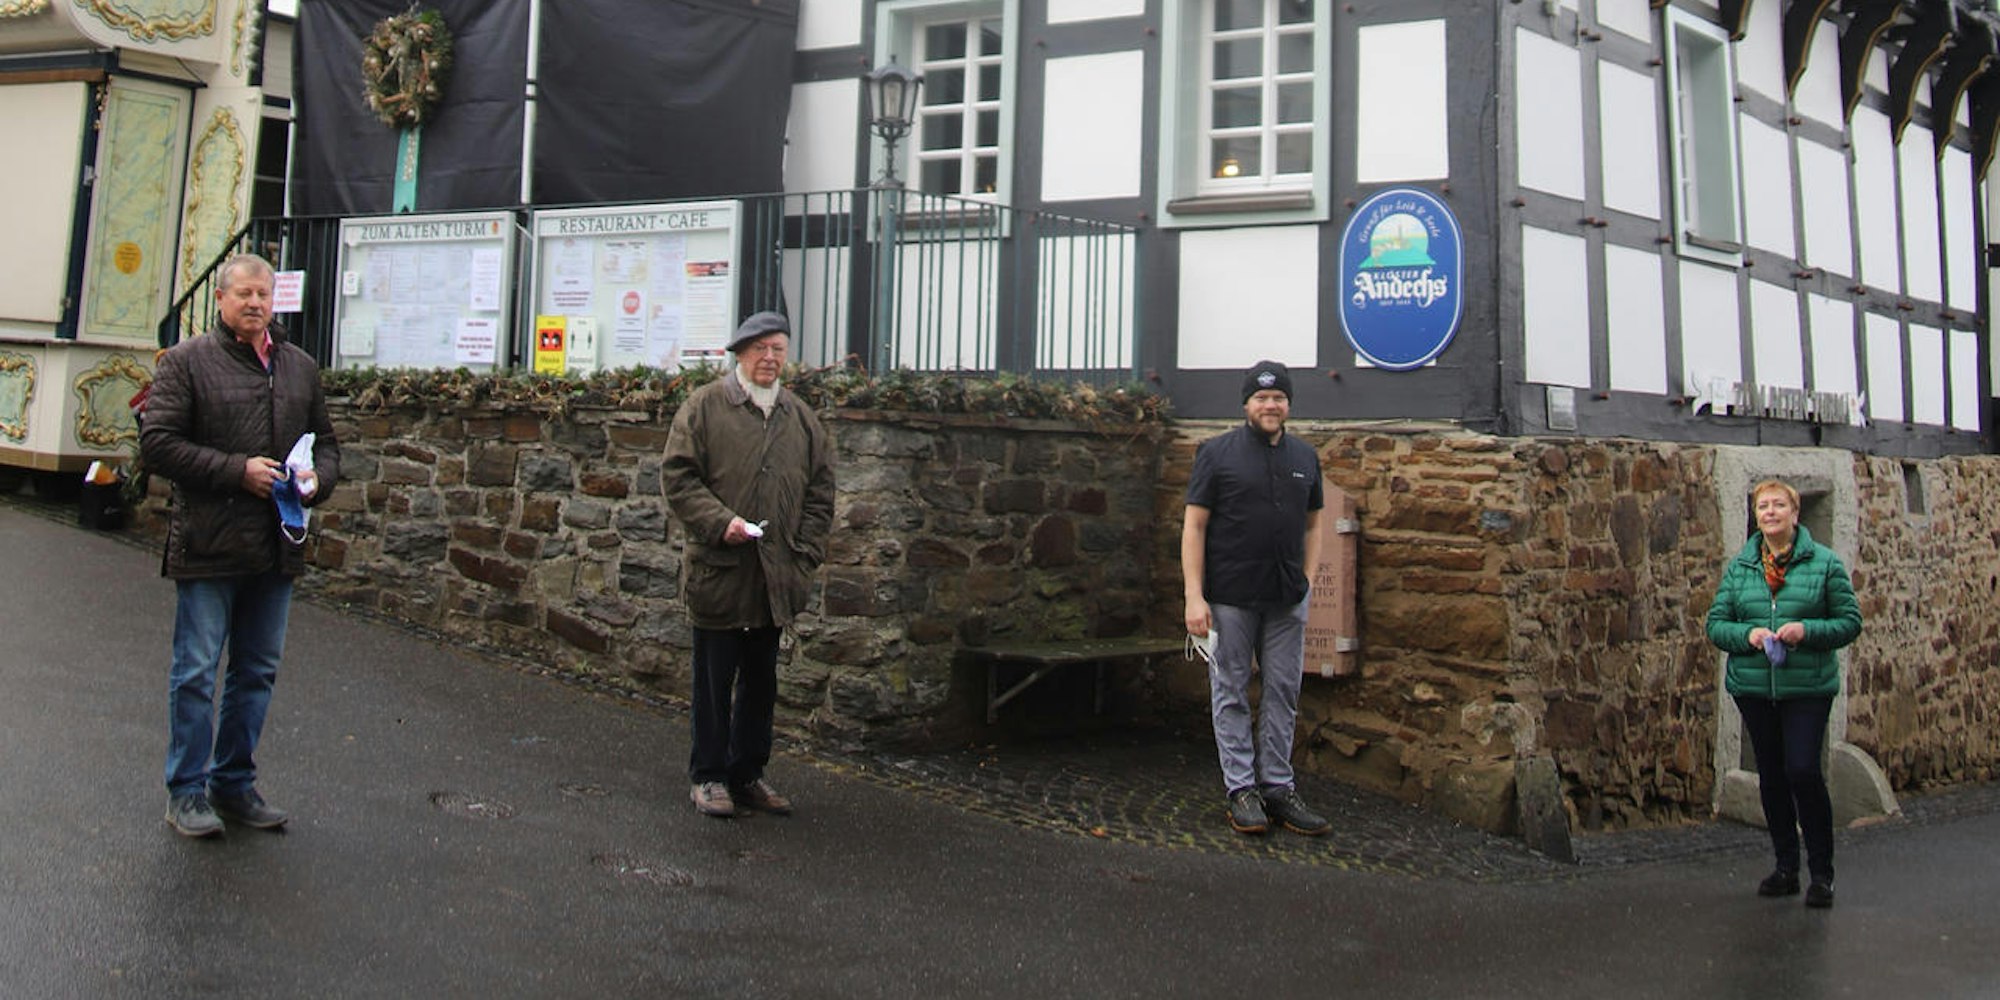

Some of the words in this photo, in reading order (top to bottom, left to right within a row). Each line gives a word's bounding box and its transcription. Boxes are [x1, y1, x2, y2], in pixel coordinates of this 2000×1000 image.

[361, 224, 391, 240] ZUM
[394, 223, 440, 239] ALTEN
[445, 222, 486, 237] TURM
[560, 215, 657, 233] RESTAURANT
[668, 213, 708, 228] CAFE
[1372, 270, 1420, 279] KLOSTER
[1352, 266, 1448, 309] Andechs
